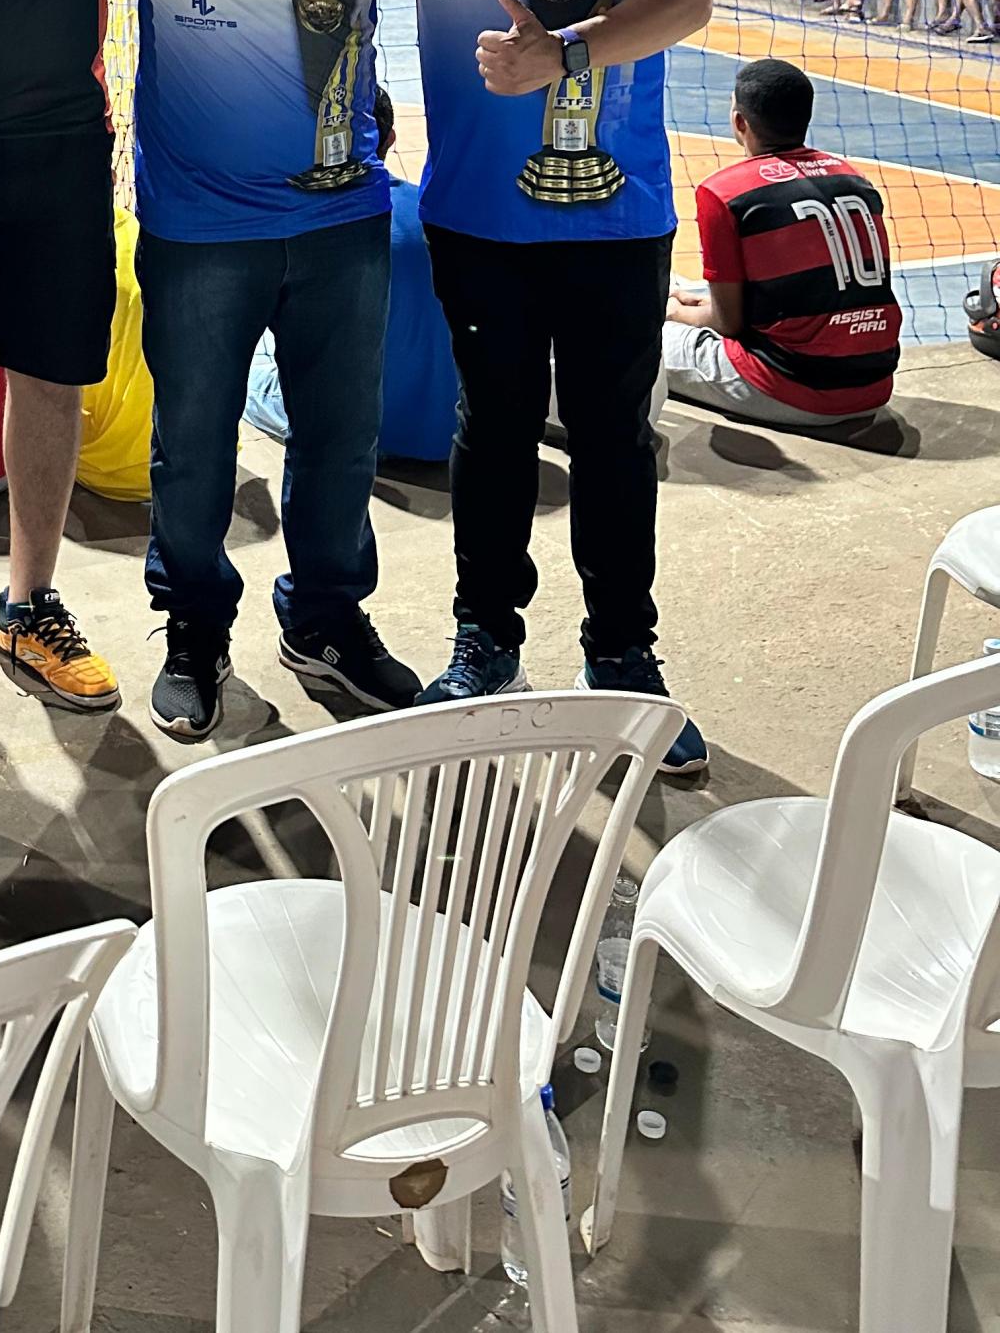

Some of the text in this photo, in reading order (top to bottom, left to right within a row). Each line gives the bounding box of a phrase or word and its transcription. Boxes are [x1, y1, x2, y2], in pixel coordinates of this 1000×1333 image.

[174, 14, 238, 28] SPORTS
[557, 98, 593, 106] FTFS
[801, 168, 828, 177] livre
[829, 308, 885, 326] ASSIST
[849, 320, 887, 335] CARD
